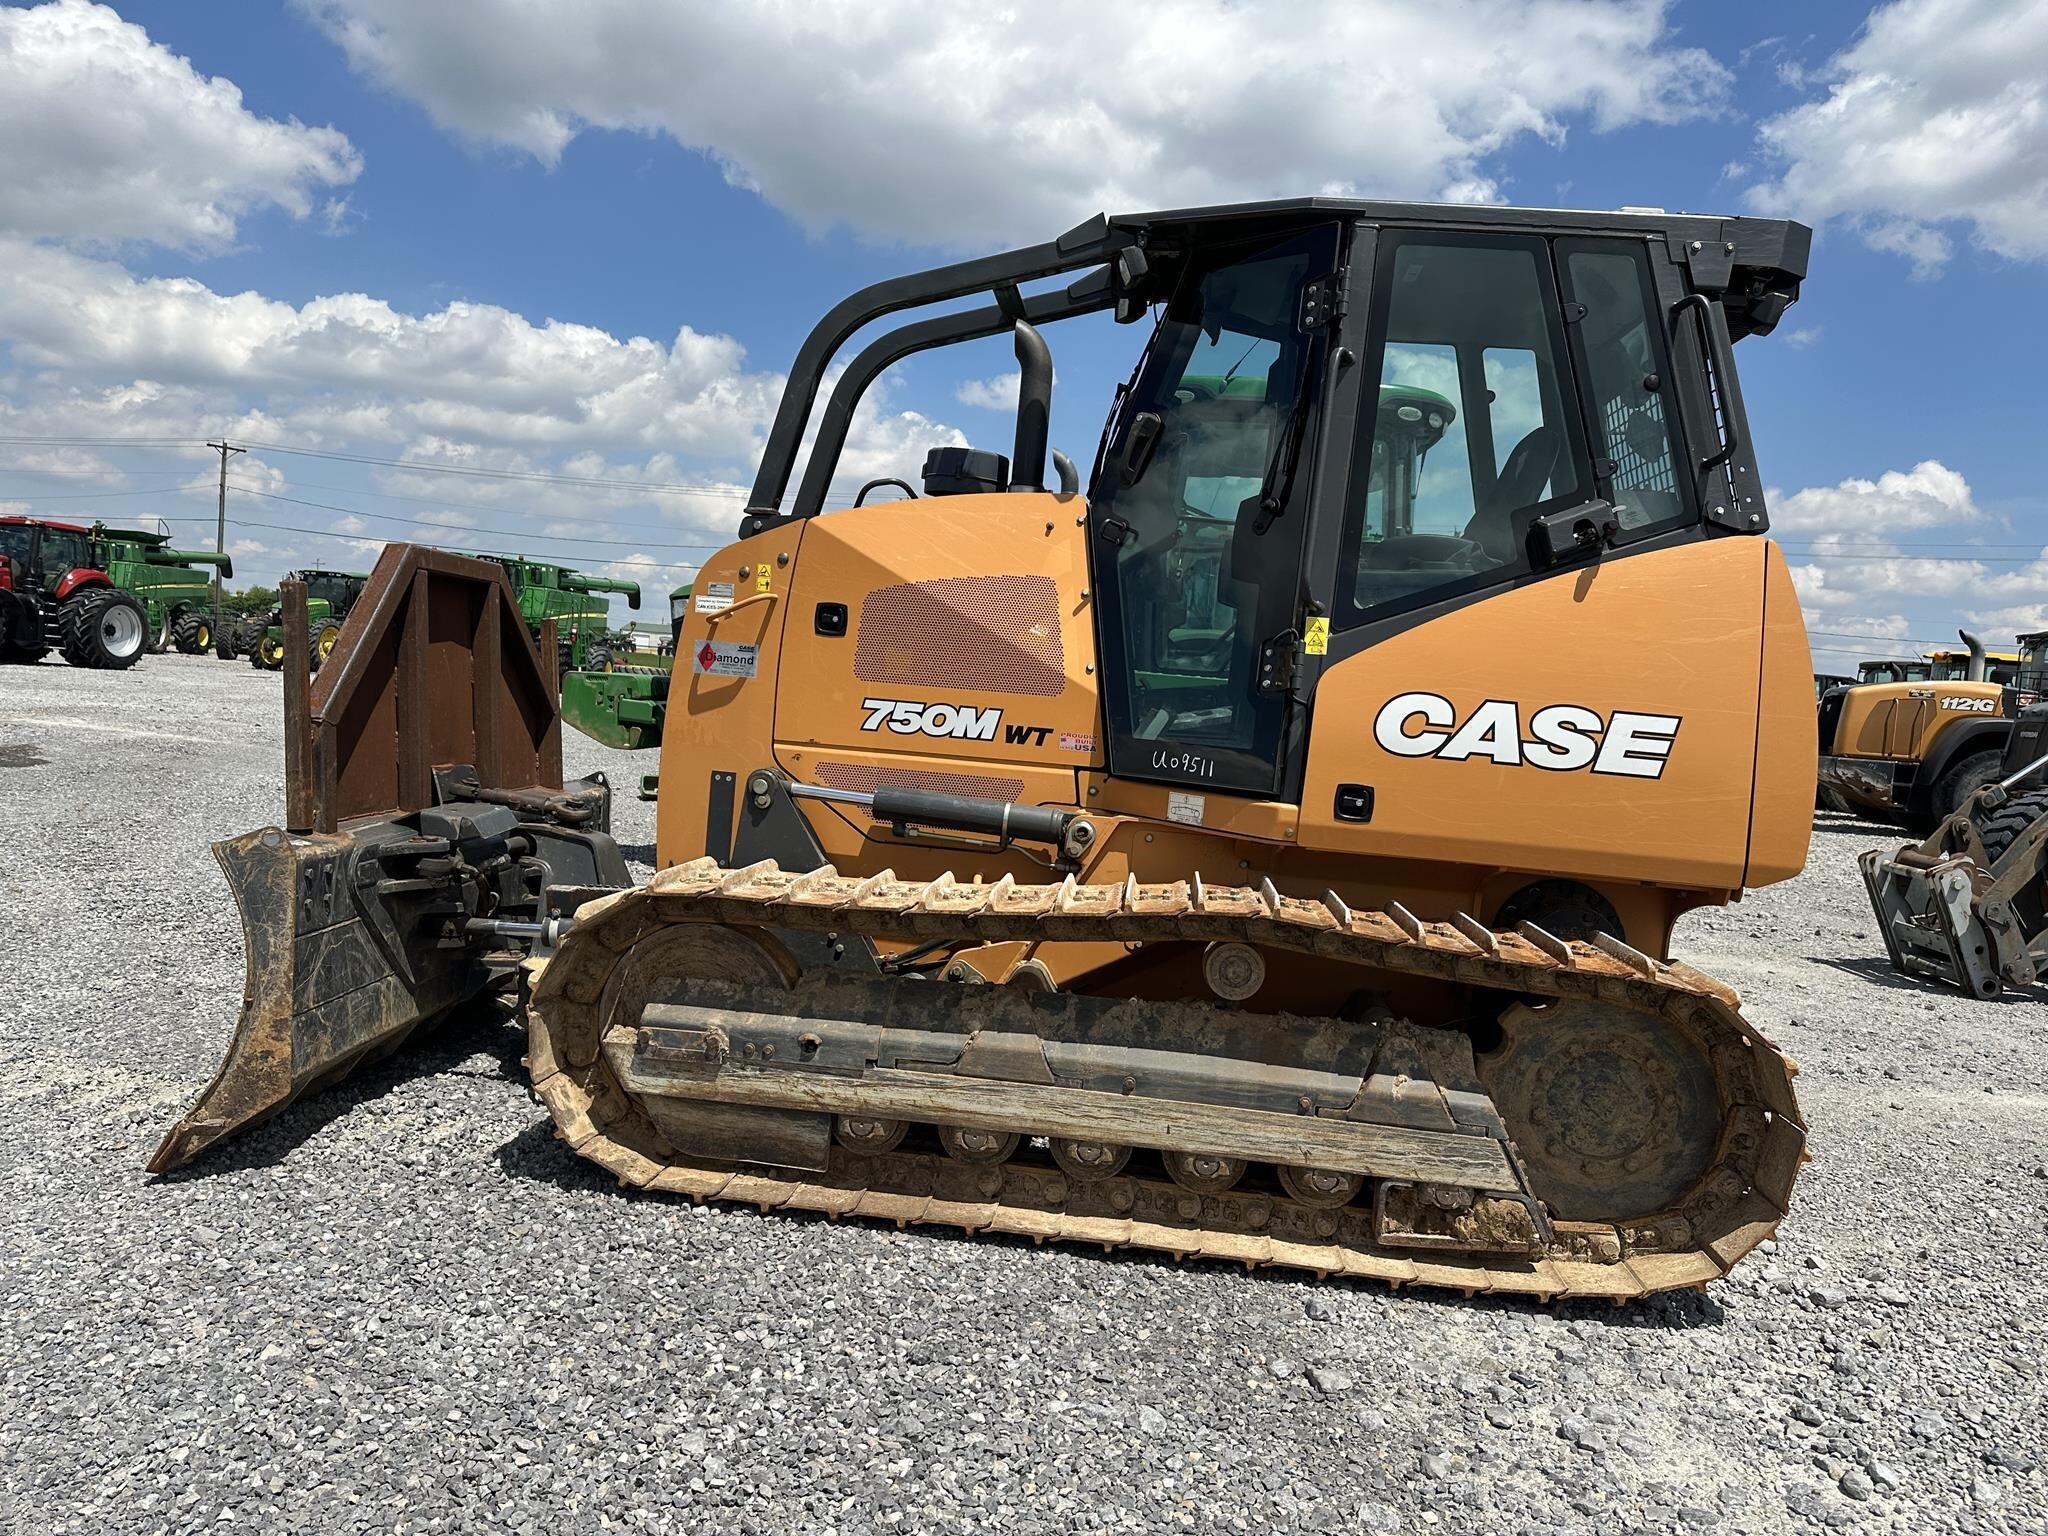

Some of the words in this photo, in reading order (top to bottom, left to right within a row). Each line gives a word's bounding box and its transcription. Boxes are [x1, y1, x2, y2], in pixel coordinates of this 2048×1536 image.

[705, 652, 754, 665] Diamond
[1941, 696, 1995, 712] 1121G
[860, 697, 1004, 742] 750M
[1005, 724, 1054, 747] WT
[1373, 691, 1683, 780] CASE
[1074, 744, 1096, 752] USA
